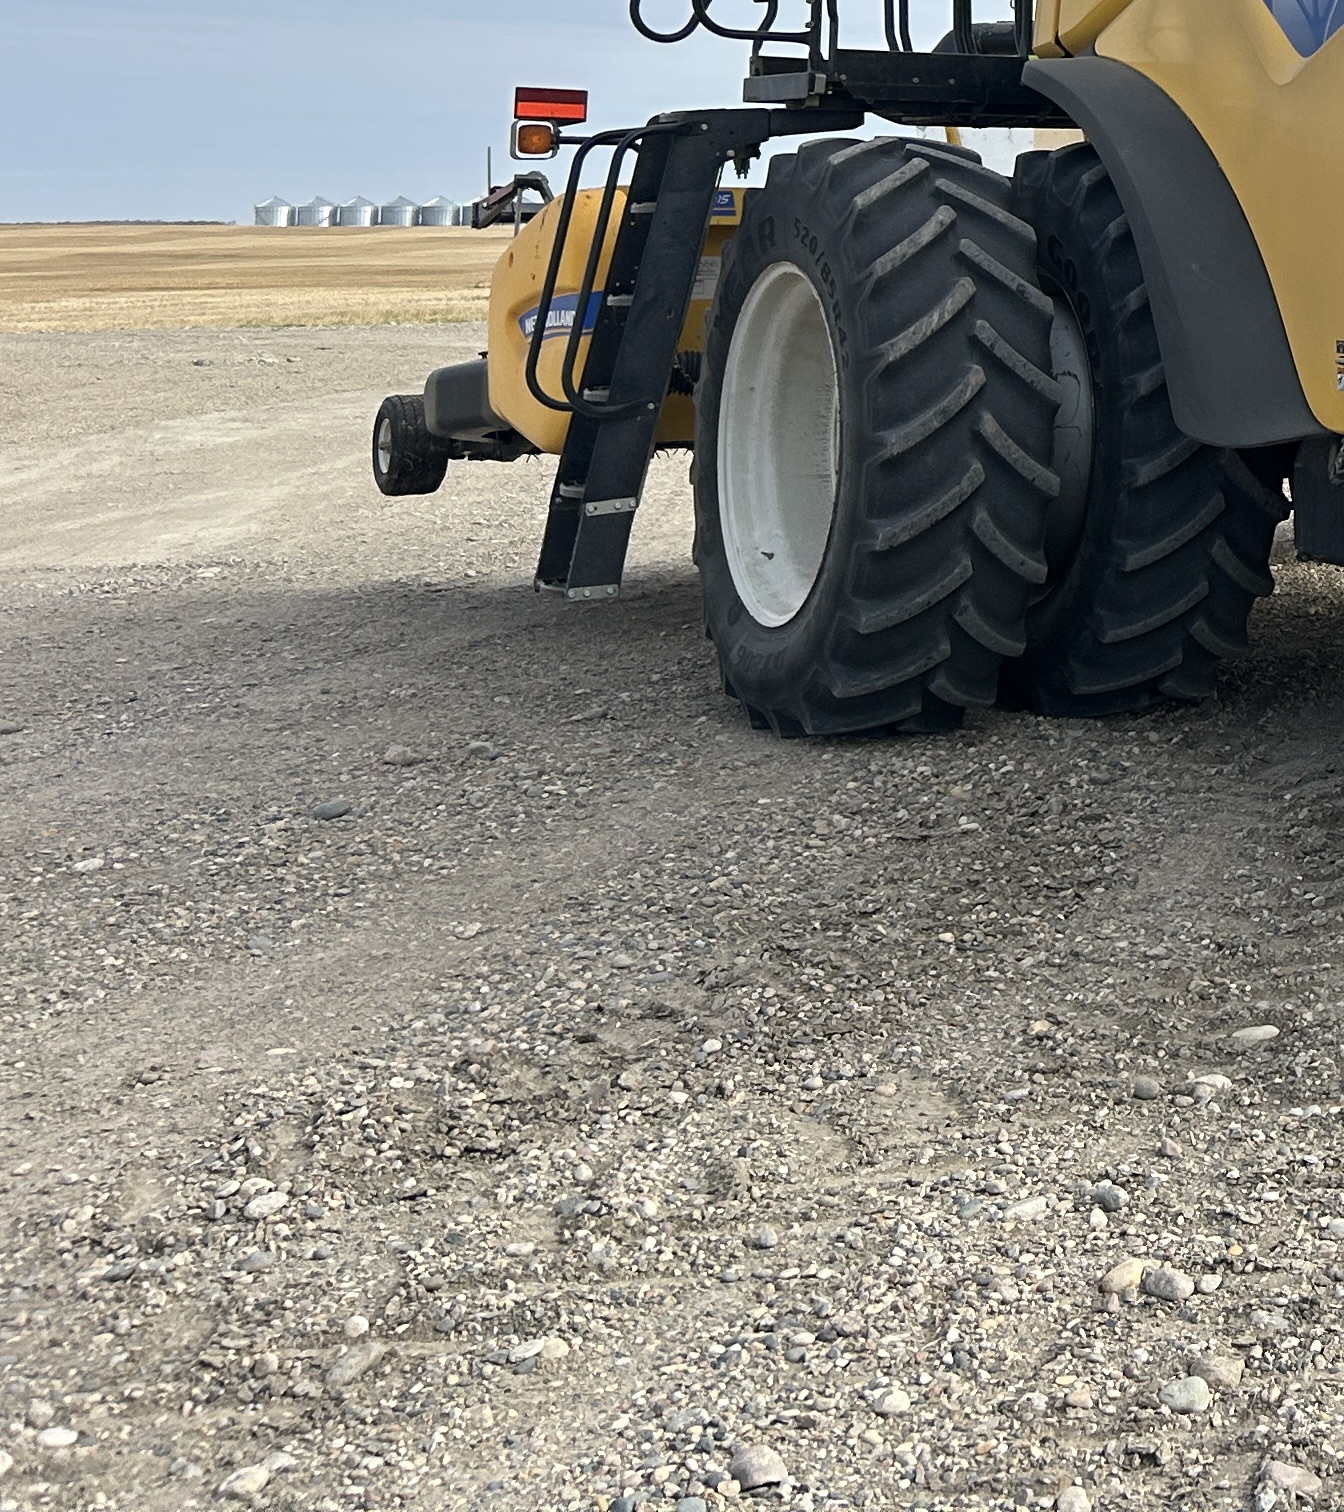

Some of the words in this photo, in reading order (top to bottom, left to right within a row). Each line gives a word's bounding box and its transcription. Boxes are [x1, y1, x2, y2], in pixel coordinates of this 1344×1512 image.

[525, 314, 538, 335] NE
[545, 310, 576, 327] OLLAN
[793, 216, 850, 372] 520/85R42
